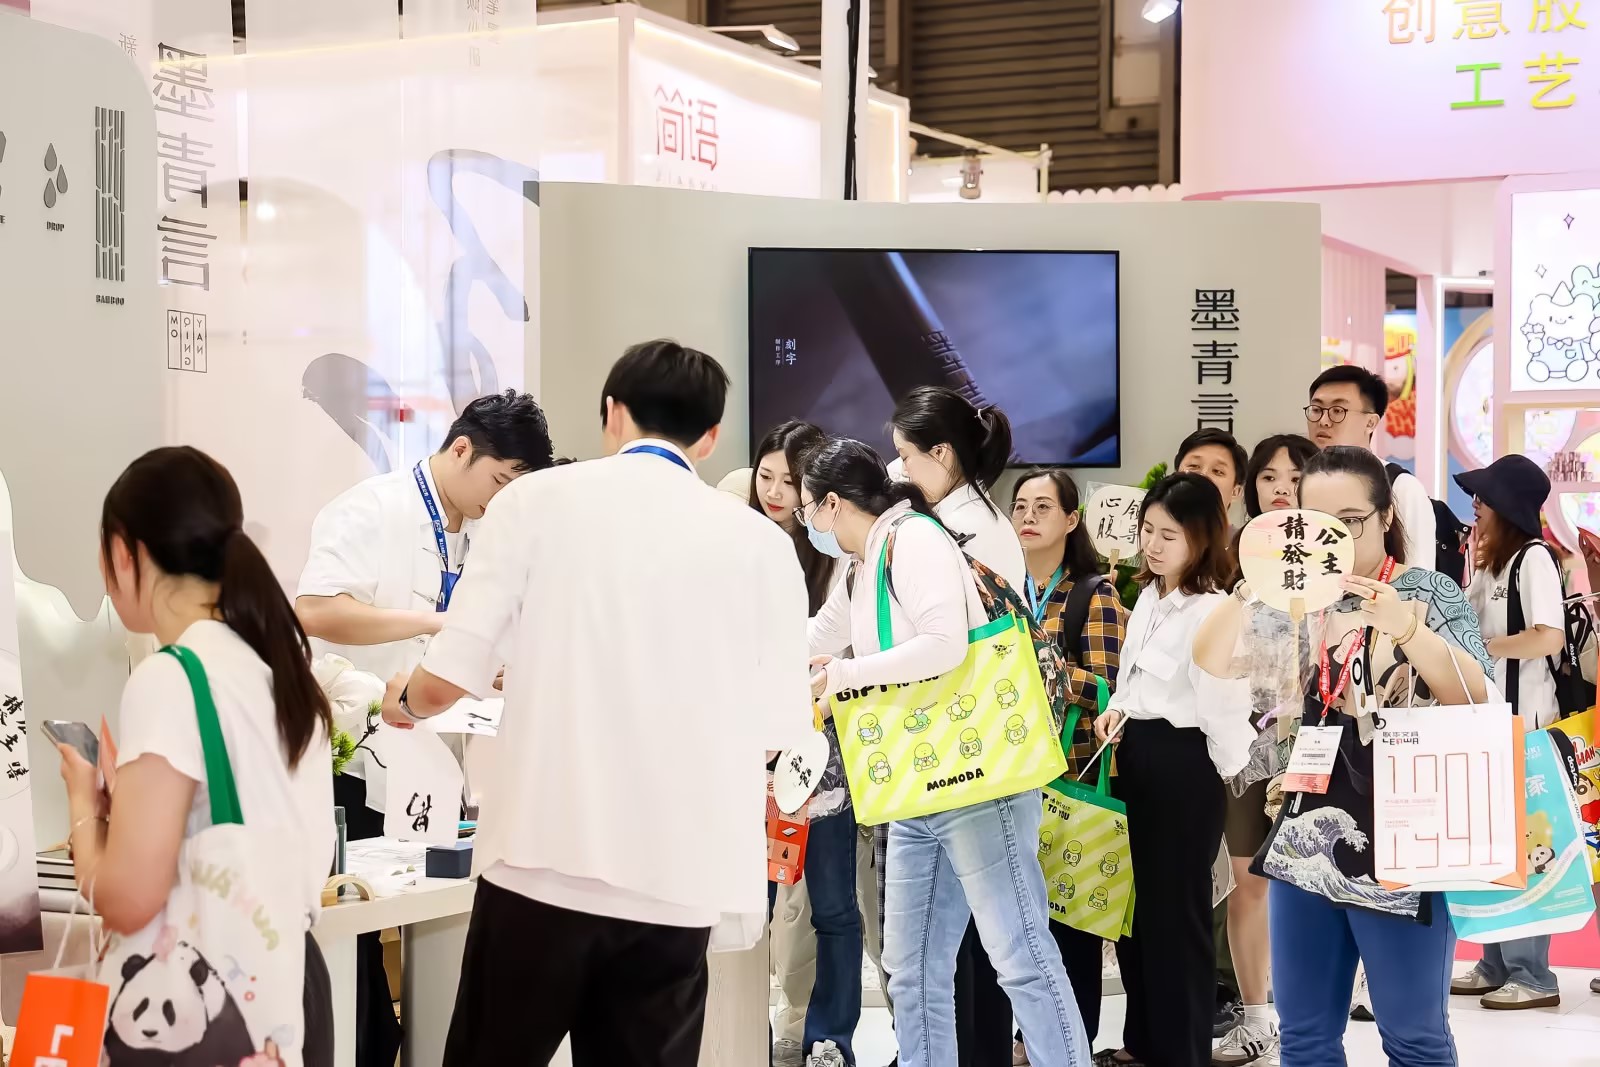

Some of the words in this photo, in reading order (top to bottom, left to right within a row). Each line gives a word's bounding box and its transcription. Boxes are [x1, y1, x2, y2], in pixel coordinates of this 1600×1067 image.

[1449, 52, 1581, 110] 工艺
[654, 84, 719, 171] 简语
[46, 221, 65, 232] DROP
[95, 294, 125, 306] BAMBOO
[1190, 288, 1240, 436] 墨青言
[1277, 513, 1313, 591] 請發財
[1314, 527, 1348, 576] 公主
[926, 767, 985, 792] MOMODA
[1047, 803, 1057, 814] TO
[1058, 809, 1070, 821] YOU
